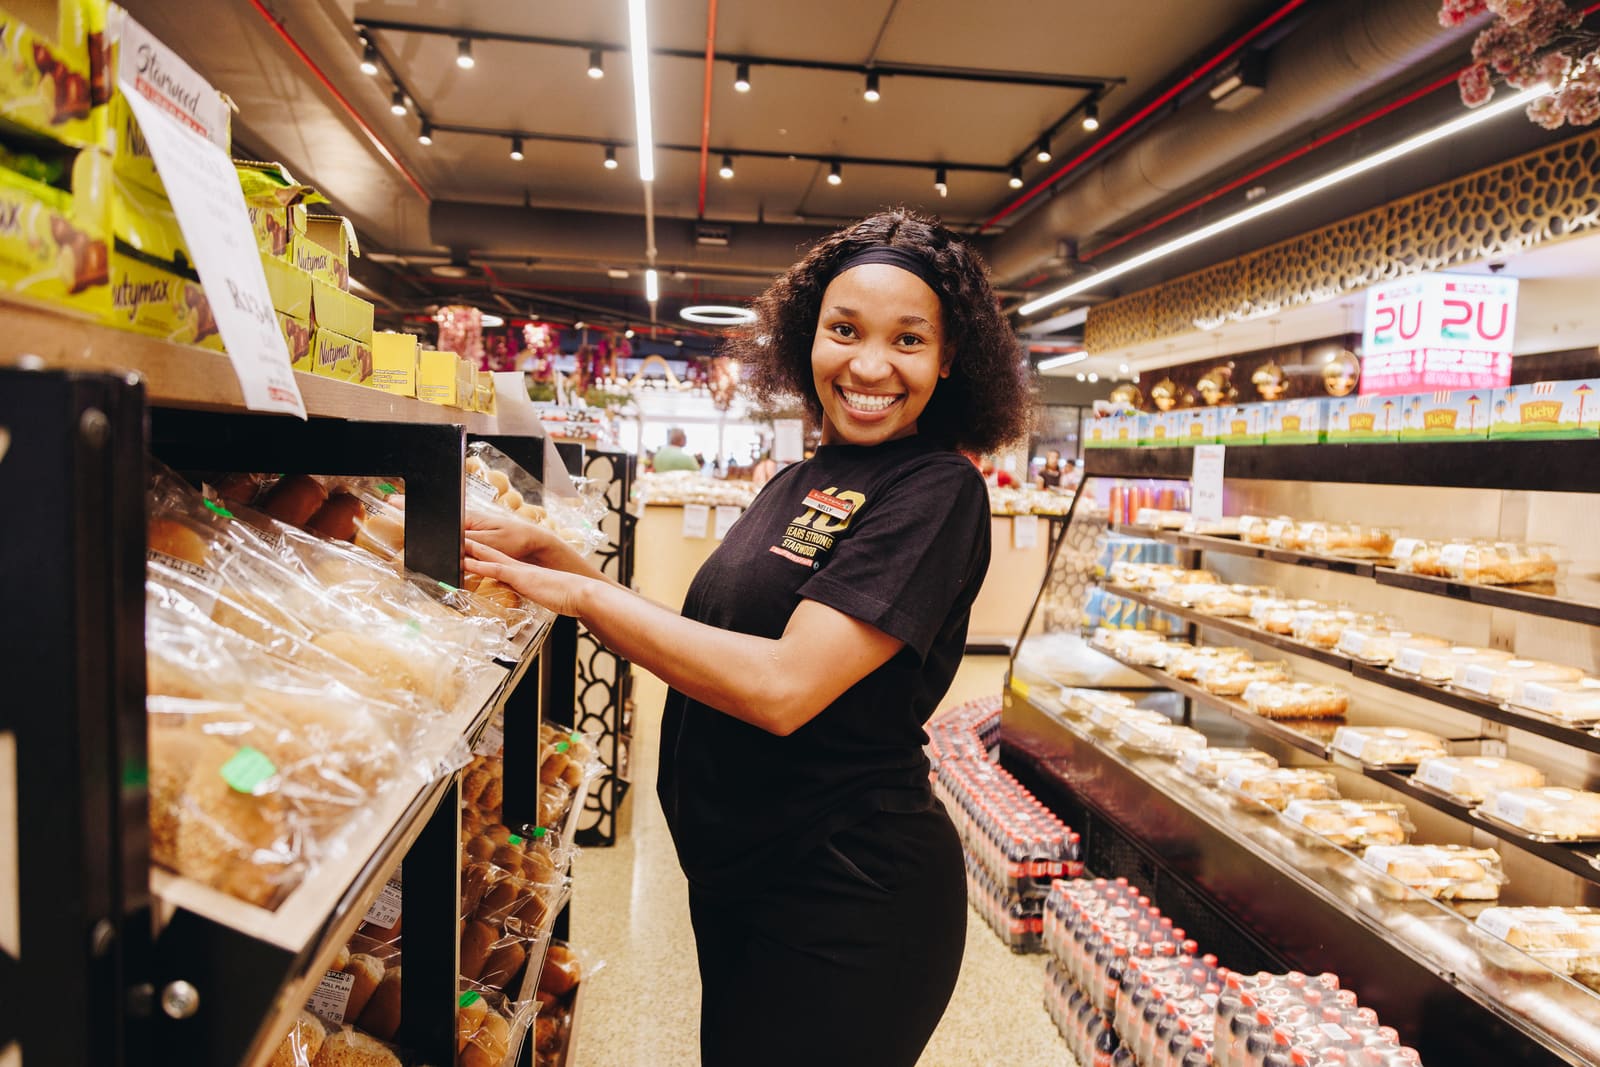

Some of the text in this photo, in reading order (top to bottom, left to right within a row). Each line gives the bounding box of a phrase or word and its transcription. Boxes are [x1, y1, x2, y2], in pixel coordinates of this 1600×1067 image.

[297, 245, 327, 274] Nutymax
[113, 272, 169, 321] utymax
[319, 338, 351, 370] Nutymax
[817, 503, 832, 512] NELLY
[781, 539, 817, 557] STARWOOD
[804, 531, 834, 549] STRONG
